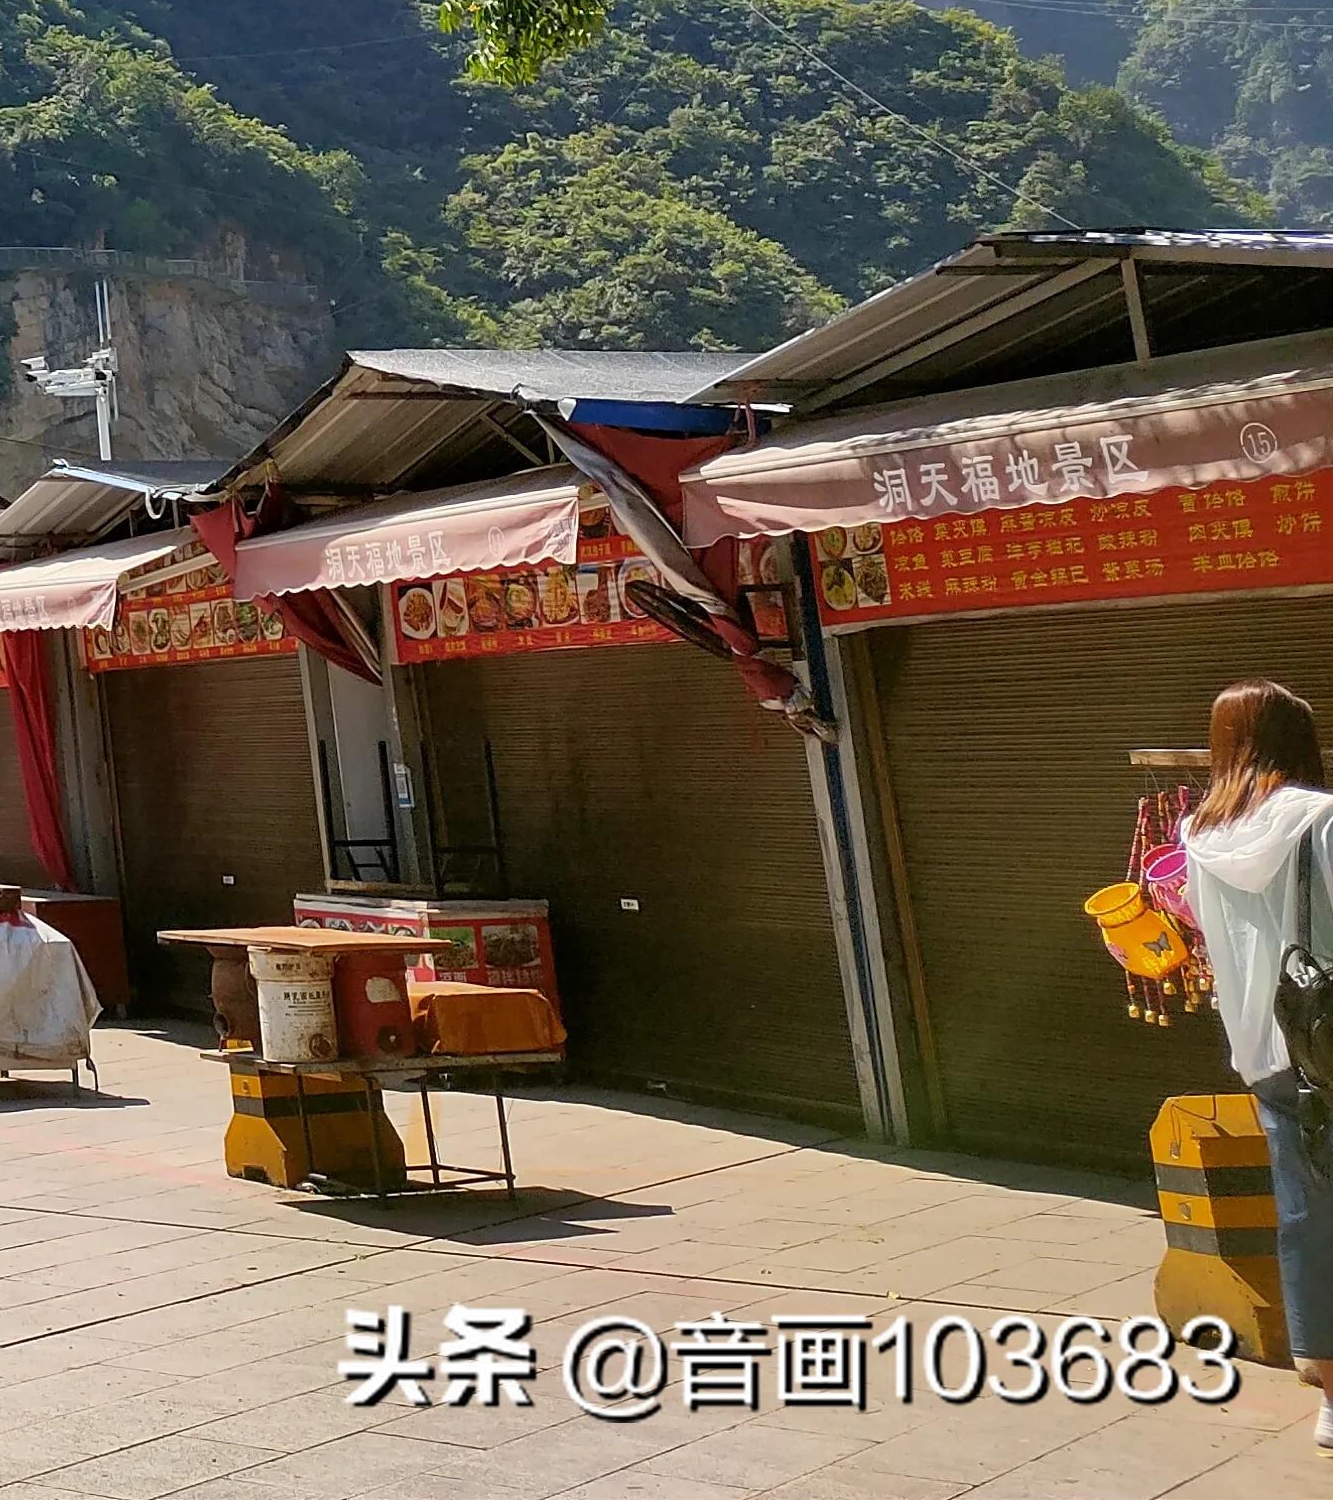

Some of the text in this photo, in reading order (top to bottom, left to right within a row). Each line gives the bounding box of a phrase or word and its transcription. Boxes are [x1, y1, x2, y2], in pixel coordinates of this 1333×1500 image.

[872, 432, 1151, 513] 洞天福地景区
[1269, 479, 1317, 504] 煎饼
[1188, 518, 1254, 542] 肉夹馍
[325, 530, 452, 581] 洞天福地景区
